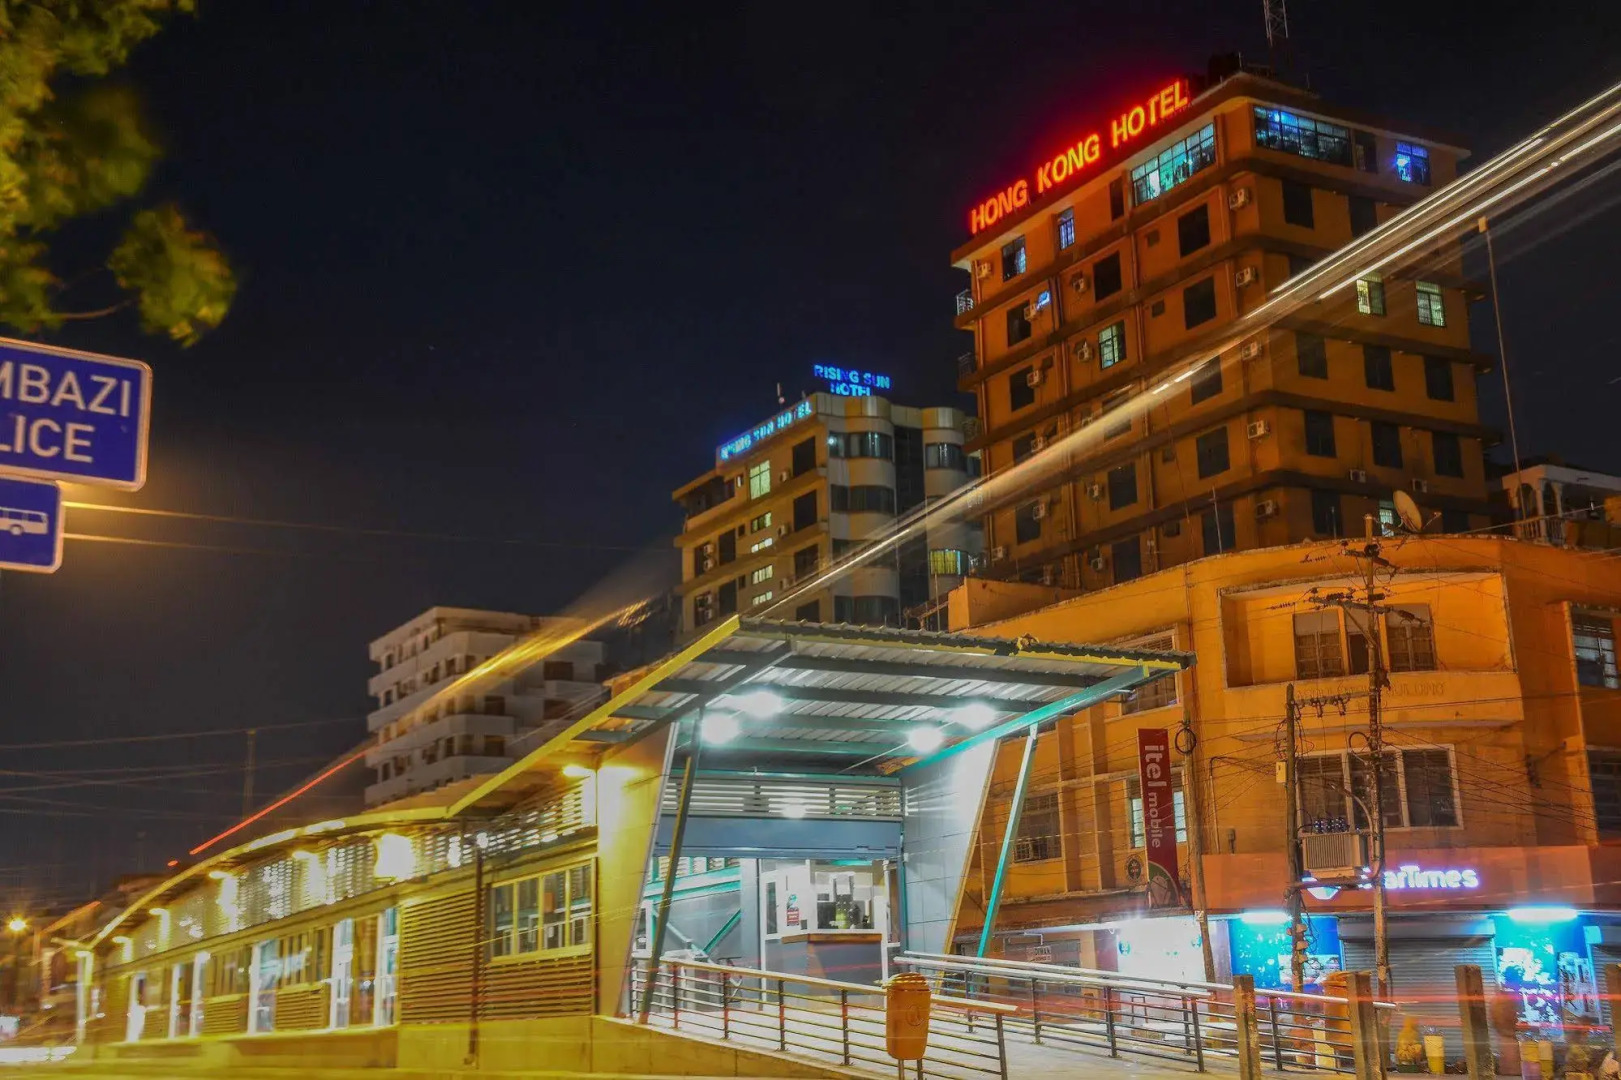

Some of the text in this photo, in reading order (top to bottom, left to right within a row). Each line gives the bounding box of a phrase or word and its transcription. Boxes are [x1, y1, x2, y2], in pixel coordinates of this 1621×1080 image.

[970, 80, 1189, 235] HONG KONG HOTEL
[814, 364, 891, 389] RISING SUN
[1144, 745, 1168, 848] itel mobile
[1357, 864, 1480, 890] arTimes
